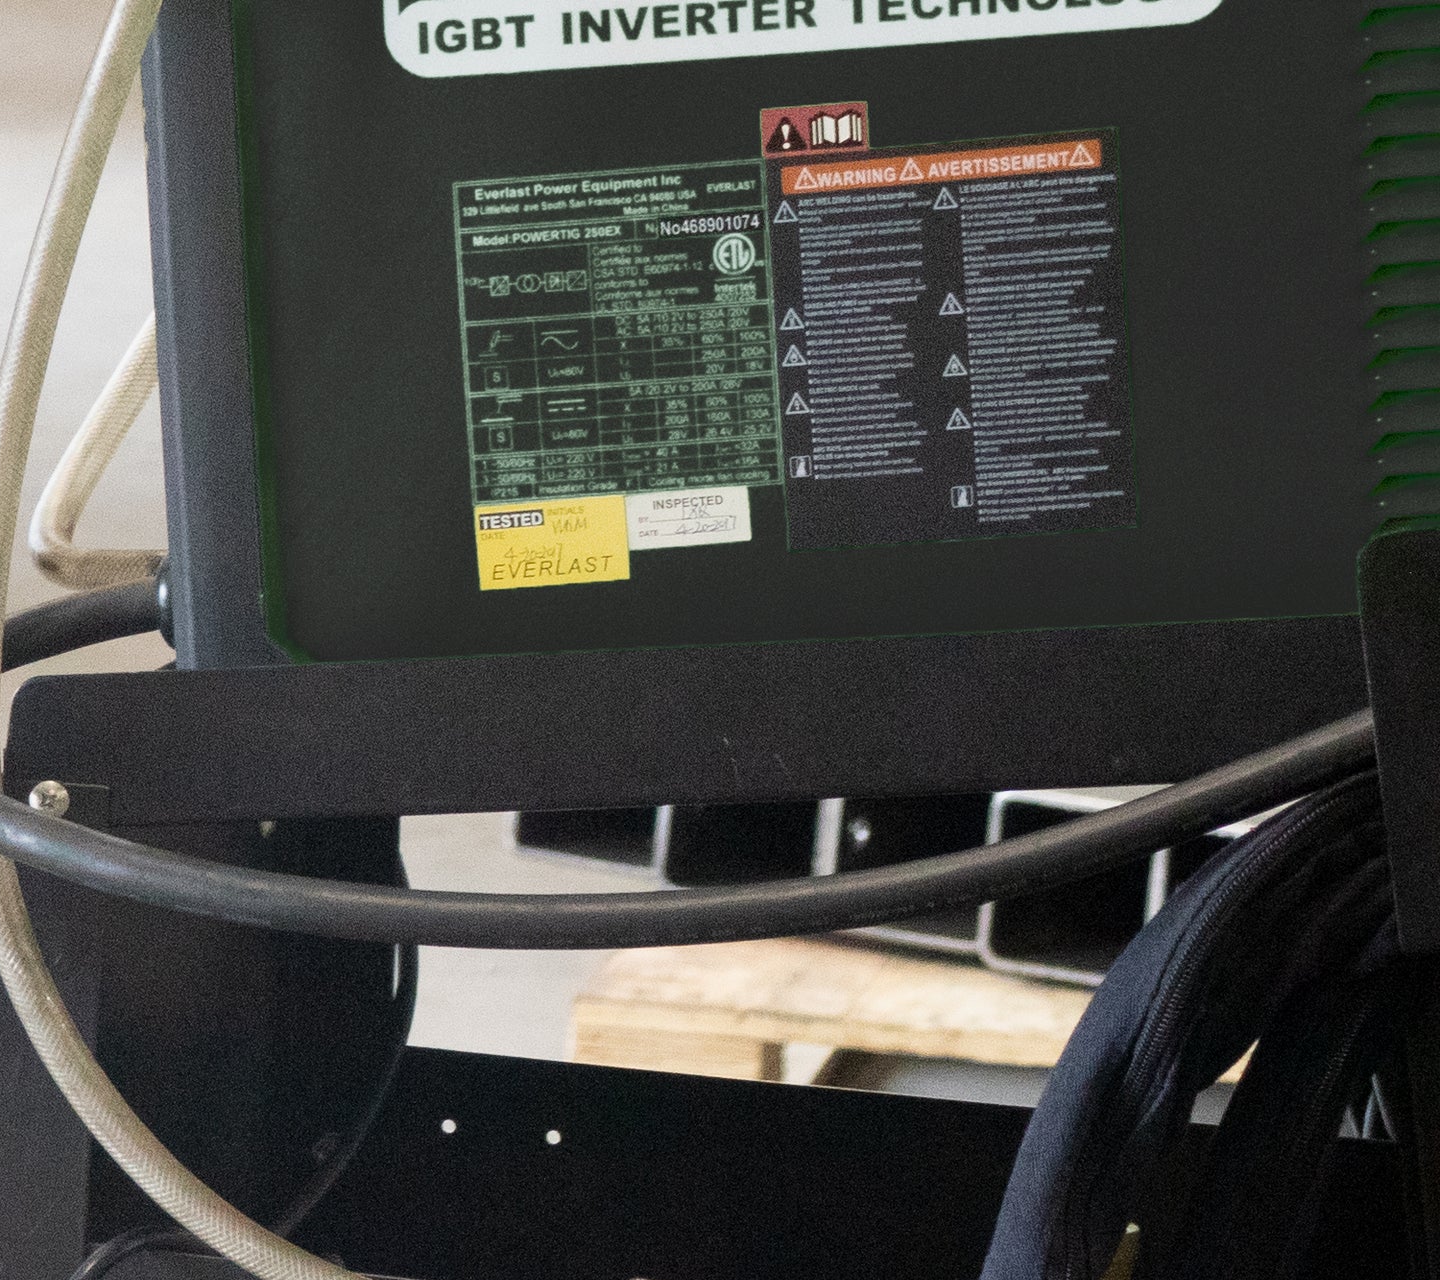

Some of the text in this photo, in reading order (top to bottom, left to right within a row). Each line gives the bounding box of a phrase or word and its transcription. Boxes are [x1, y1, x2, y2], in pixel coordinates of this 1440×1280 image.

[418, 15, 534, 55] IGBT
[561, 0, 818, 45] INVERTER
[817, 151, 1070, 187] WARNING AVERTISSEMENT
[474, 174, 682, 202] Everlast Power Equipment Inc
[706, 180, 757, 193] EVERLAST
[541, 200, 567, 211] South
[569, 198, 586, 209] San
[588, 194, 632, 207] Francisco
[633, 193, 648, 203] CA
[677, 189, 698, 200] USA
[622, 202, 689, 215] Made in China
[584, 225, 622, 239] 250EX
[660, 213, 760, 236] No468901074
[653, 495, 724, 510] INSPECTED
[480, 512, 544, 530] TESTED
[492, 555, 613, 581] EVERLAST
